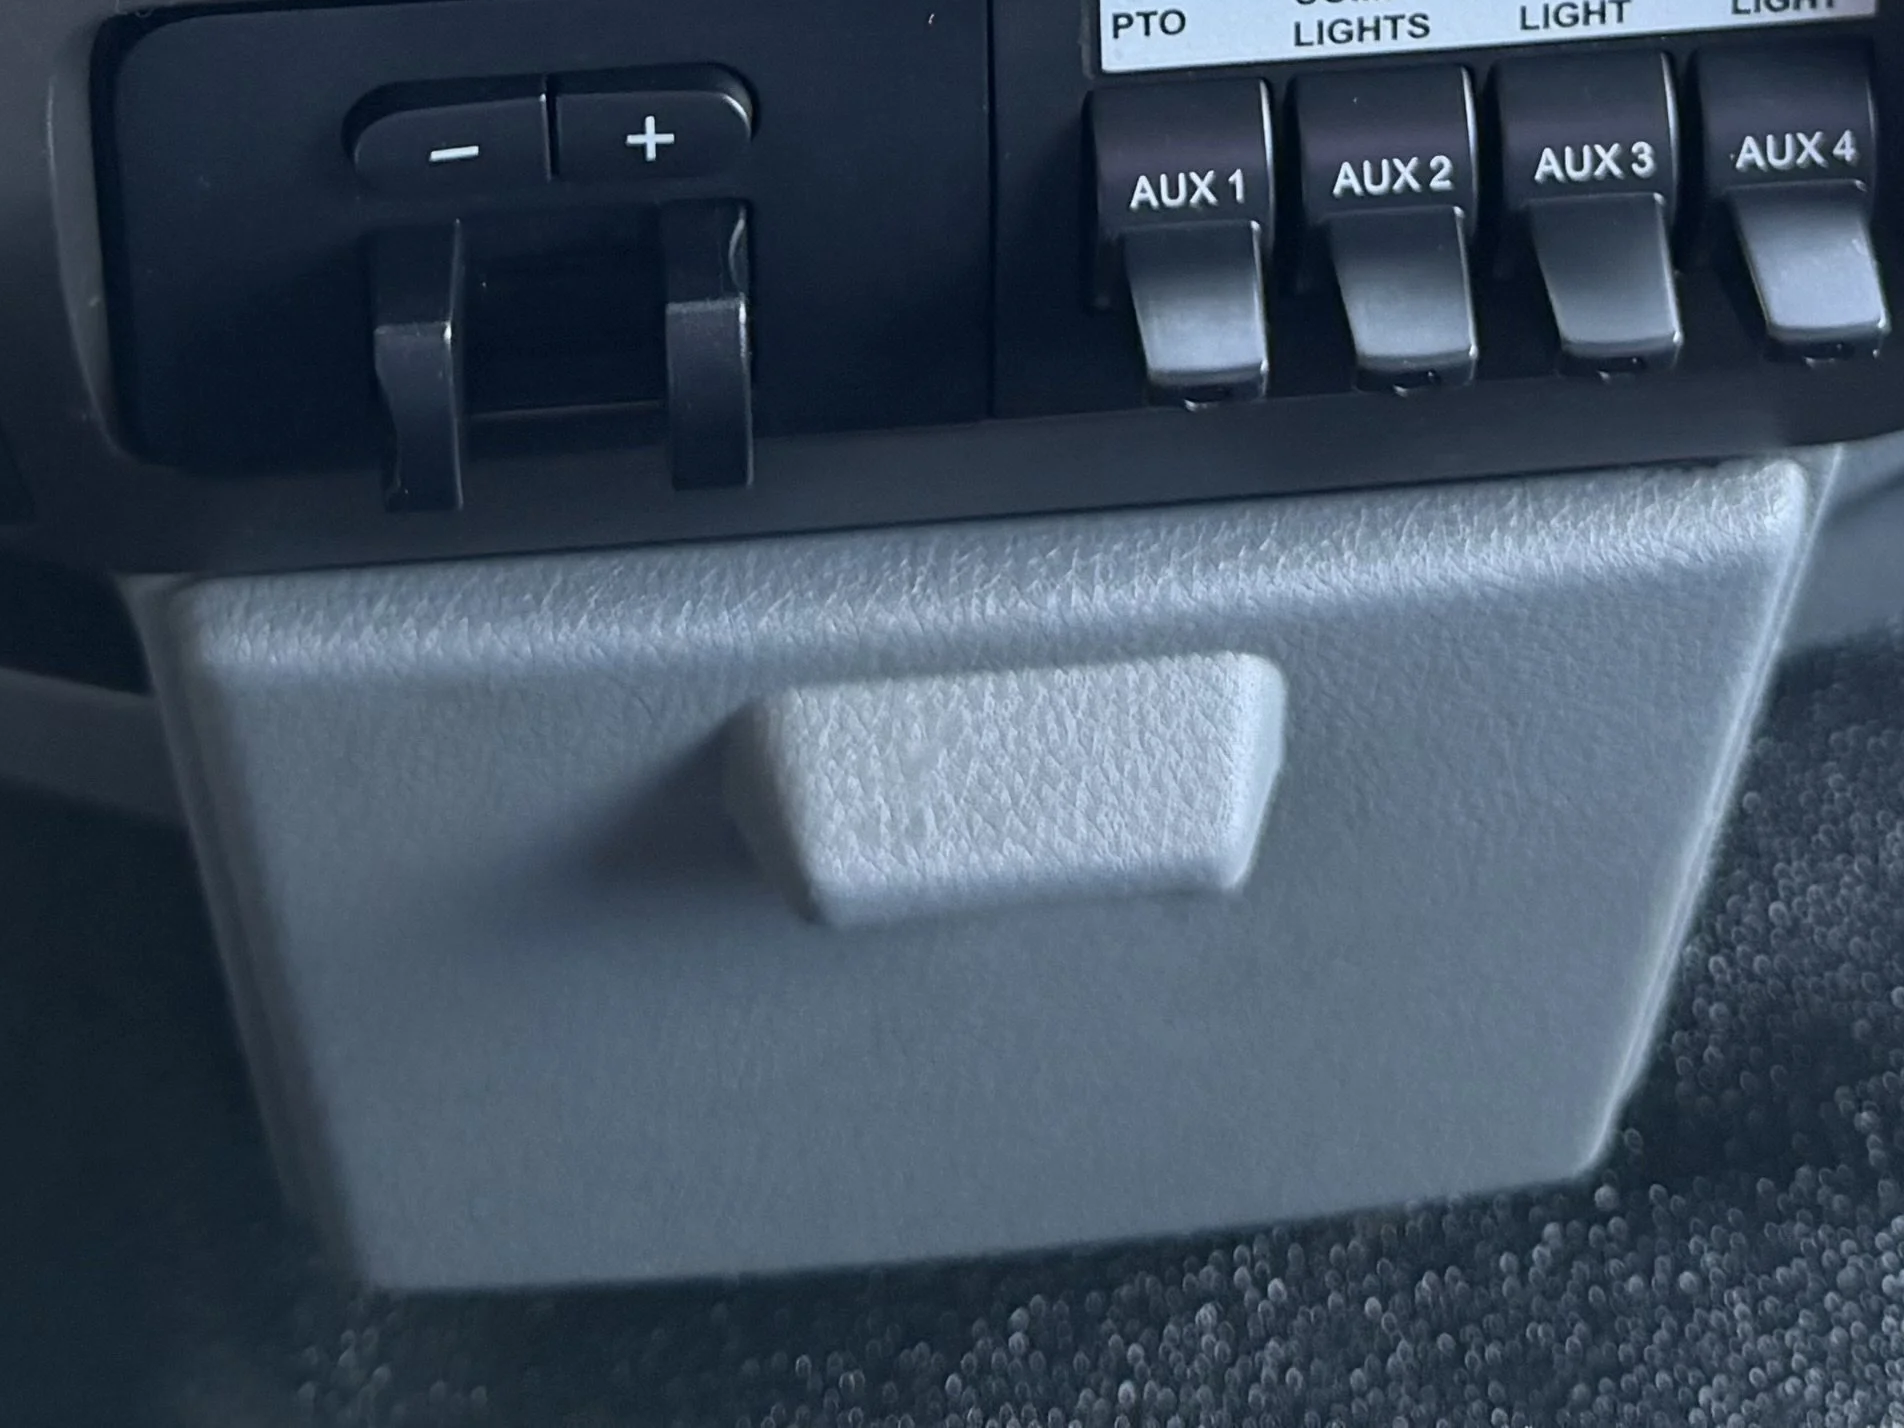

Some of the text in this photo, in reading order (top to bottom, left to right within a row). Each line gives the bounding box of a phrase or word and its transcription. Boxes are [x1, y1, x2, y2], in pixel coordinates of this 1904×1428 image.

[1111, 7, 1187, 41] PTO
[1294, 12, 1432, 48] LIGHTS
[1533, 140, 1656, 183] AUX 3
[1734, 128, 1858, 172] AUX 4
[1129, 167, 1245, 210] AUX 1
[1332, 153, 1455, 197] AUX 2
